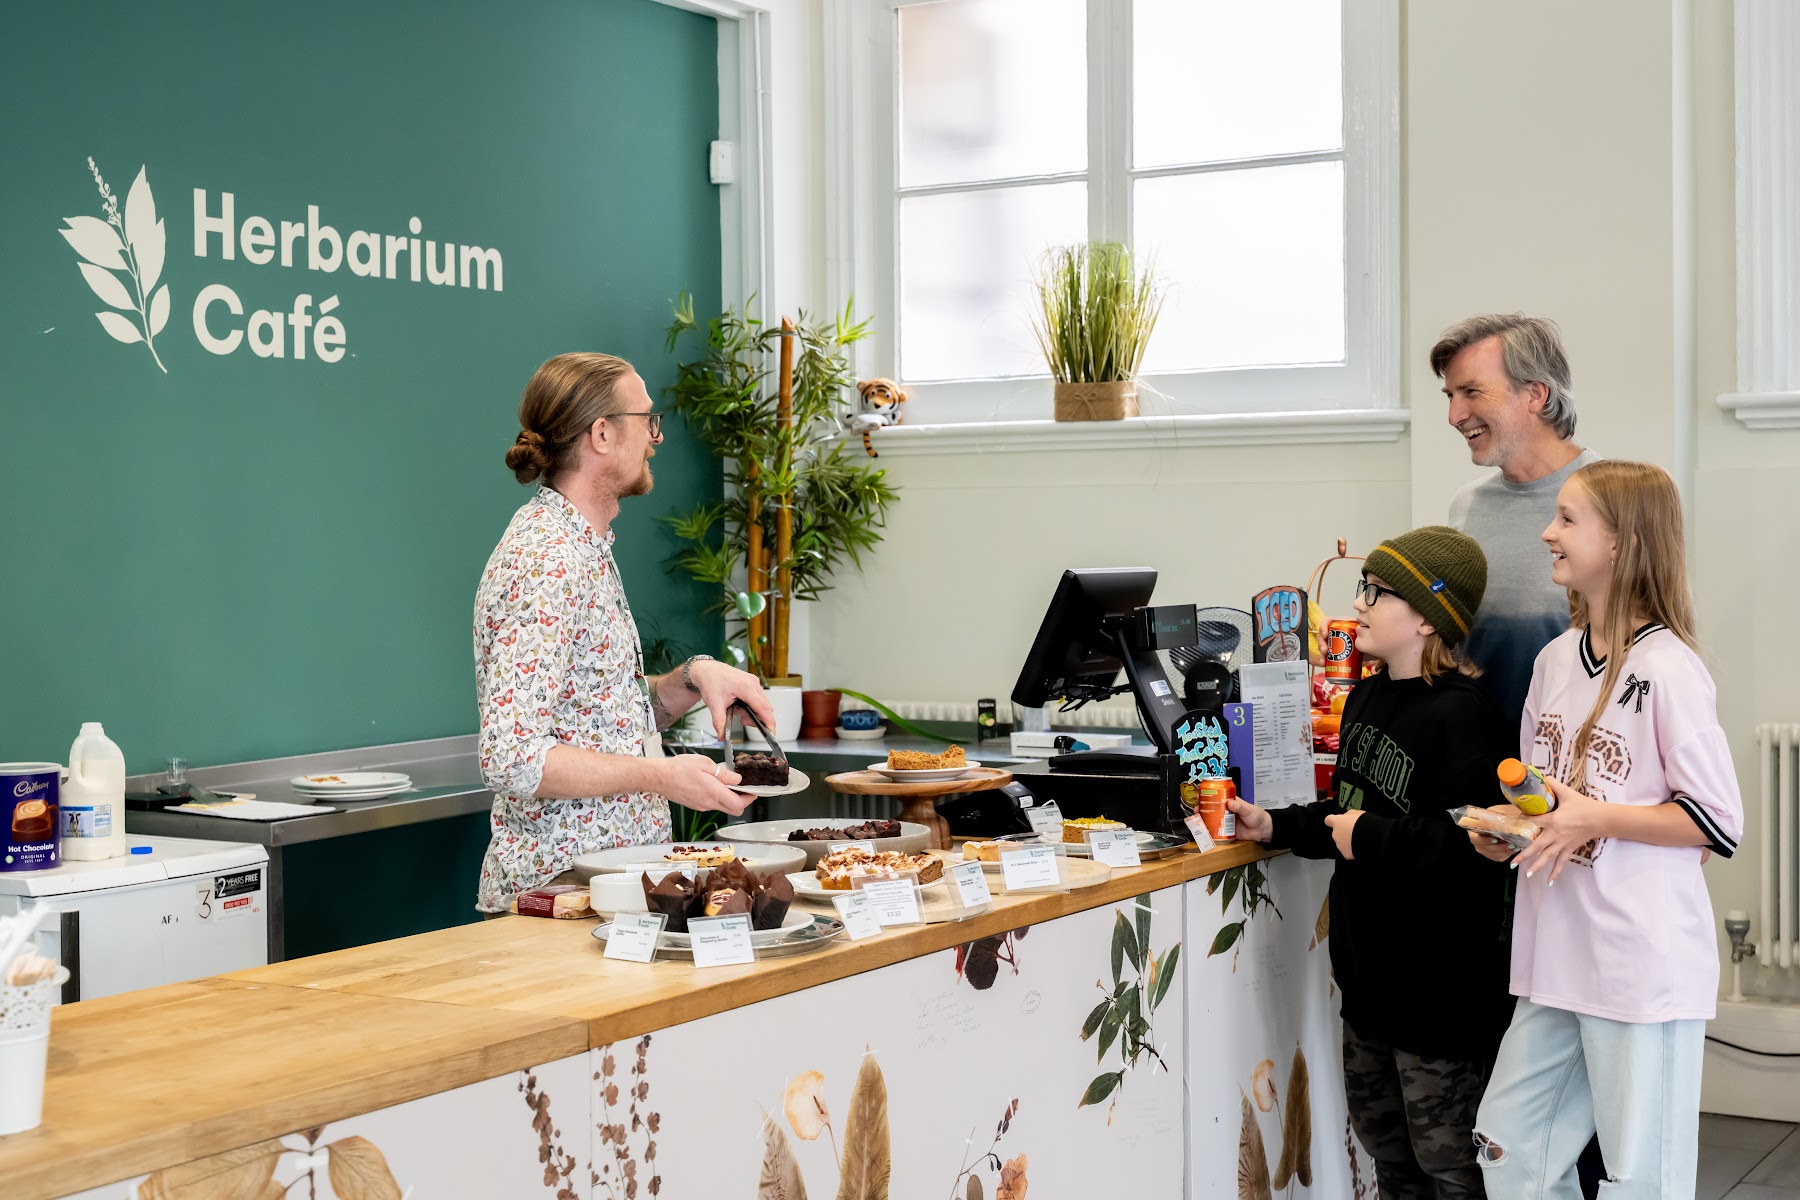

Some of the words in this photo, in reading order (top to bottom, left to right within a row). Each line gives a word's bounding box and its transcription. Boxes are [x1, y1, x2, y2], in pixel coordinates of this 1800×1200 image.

[193, 187, 504, 292] Herbarium
[192, 283, 347, 363] Café
[1256, 590, 1301, 641] ICED
[1233, 706, 1246, 726] 3
[13, 780, 50, 797] Cadbury
[8, 845, 21, 853] Hot
[22, 843, 55, 852] Chocolate
[217, 877, 227, 898] 2
[227, 876, 245, 887] YEARS
[244, 873, 259, 883] FREE
[198, 889, 211, 919] 3
